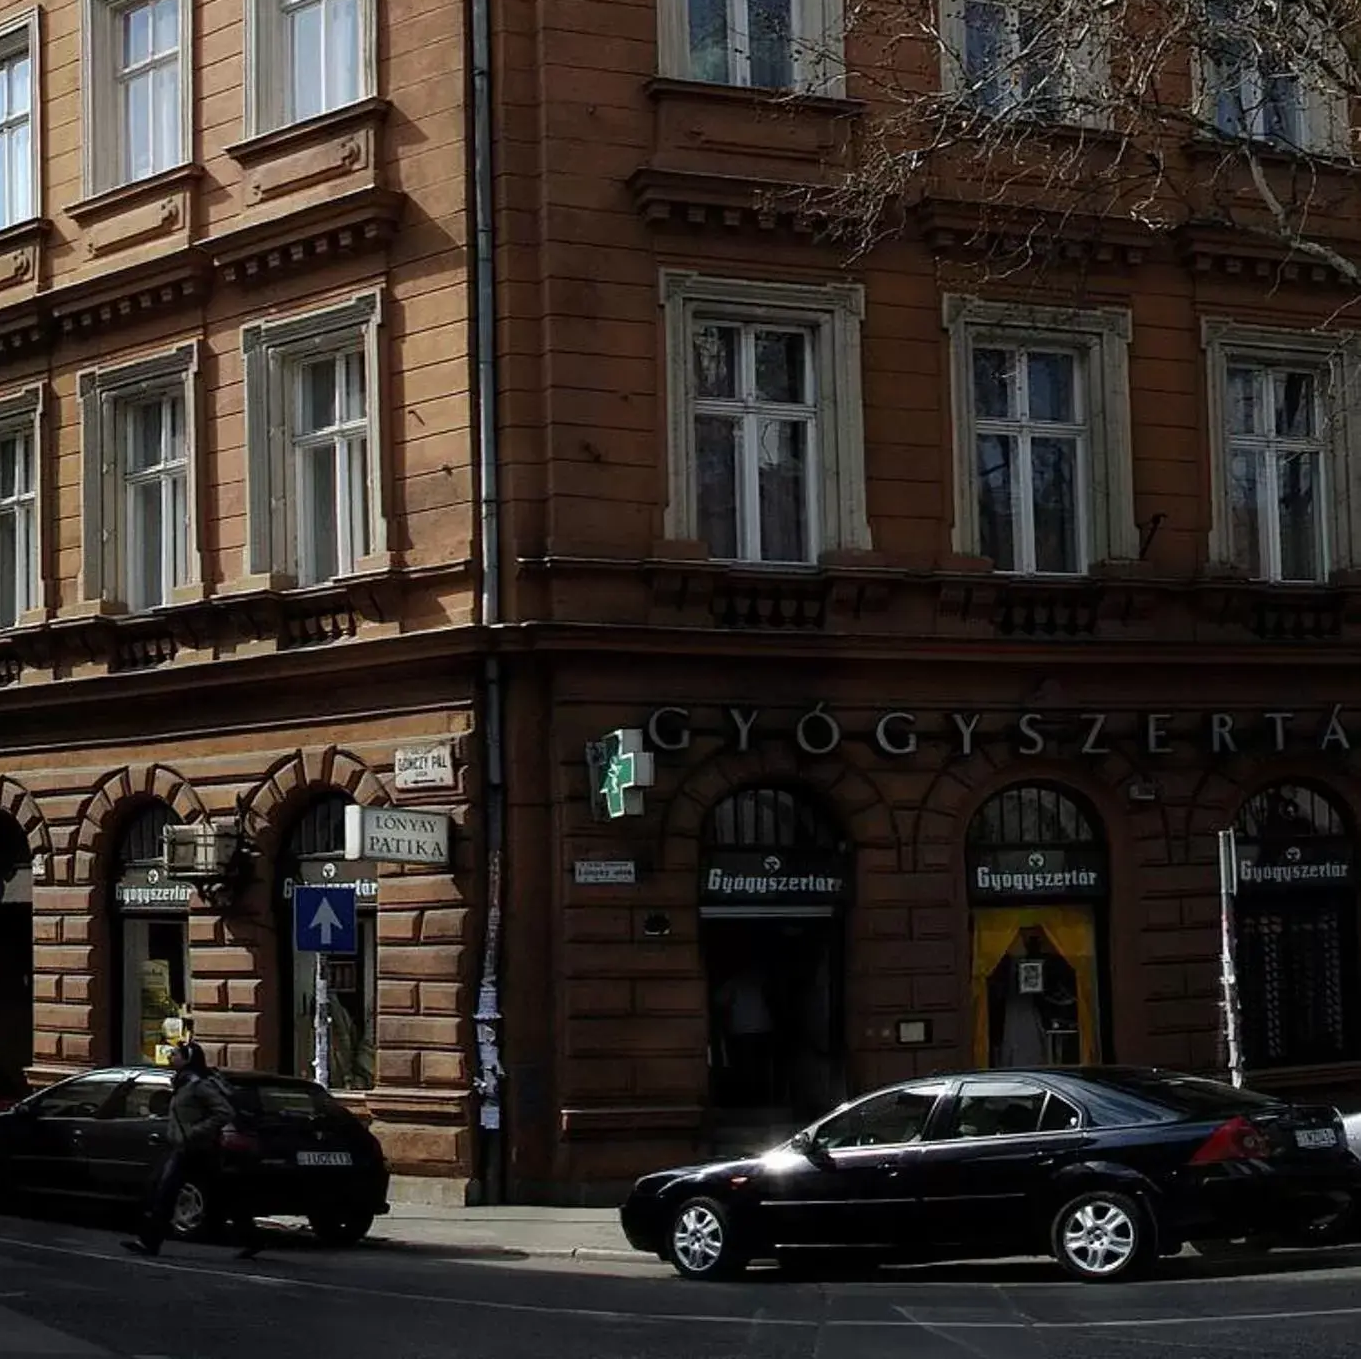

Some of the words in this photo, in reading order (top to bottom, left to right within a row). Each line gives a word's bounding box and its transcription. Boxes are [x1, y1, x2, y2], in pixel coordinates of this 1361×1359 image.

[375, 814, 437, 834] LÓNYAY
[367, 835, 445, 858] PATIKA
[976, 865, 1098, 891] Gyógyszertár
[1240, 859, 1349, 883] Gyógyszertár
